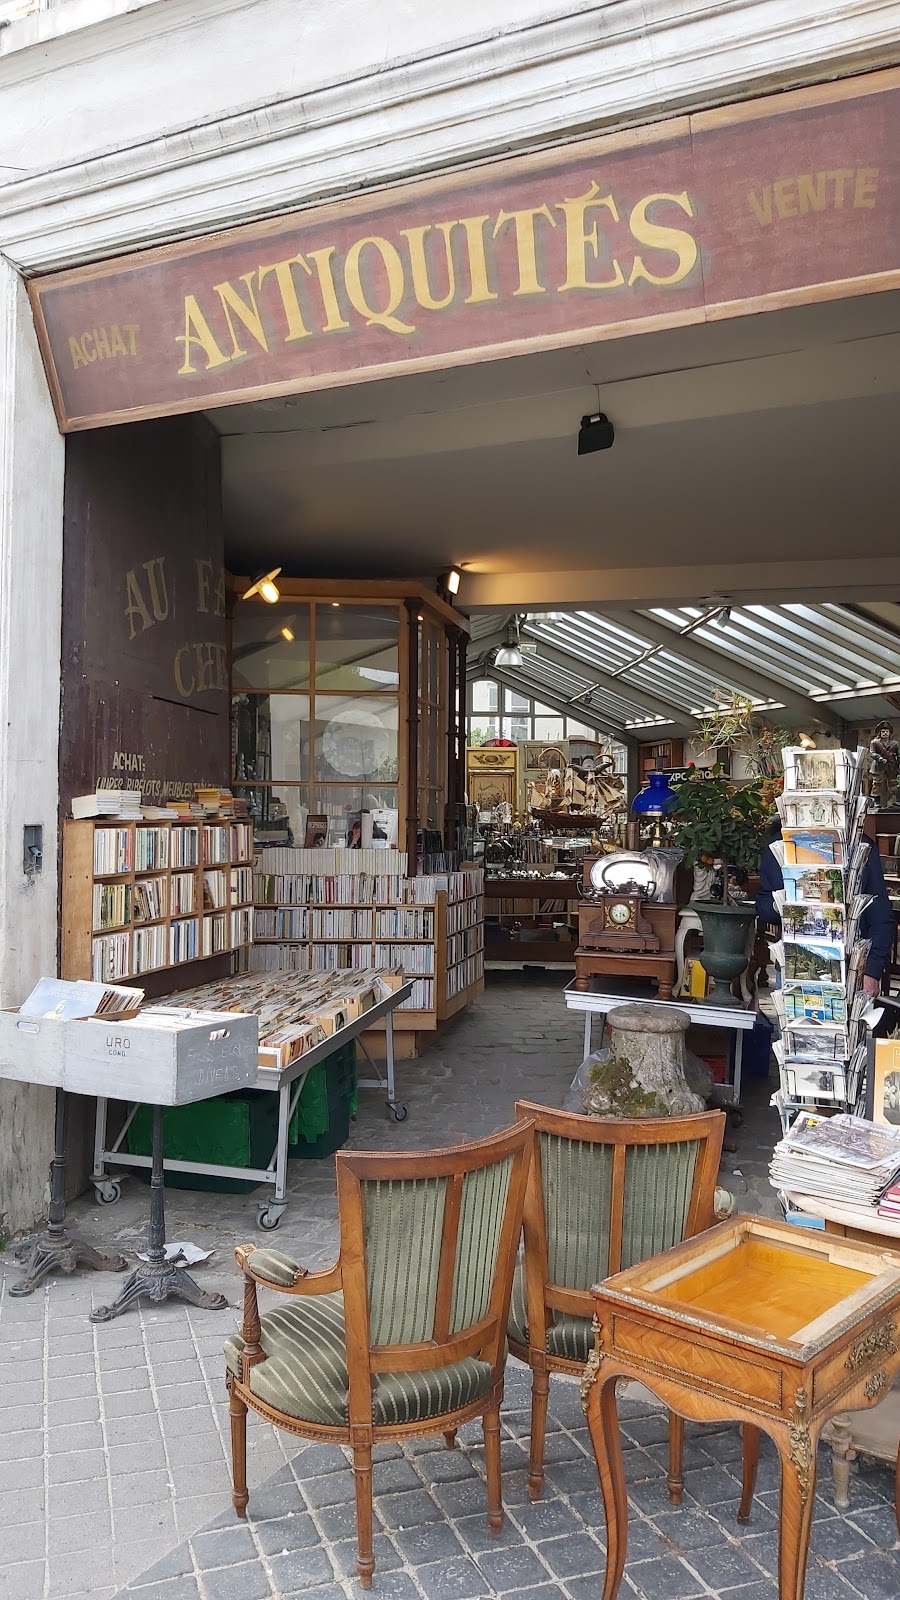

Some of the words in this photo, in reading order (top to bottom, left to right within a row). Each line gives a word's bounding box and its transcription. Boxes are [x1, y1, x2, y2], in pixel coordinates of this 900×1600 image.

[68, 324, 141, 370] ACHAT
[175, 180, 698, 376] ANTIQUITÉS
[748, 167, 880, 227] VENTE
[124, 556, 170, 641] AU
[112, 751, 146, 772] ACHAT:
[106, 1036, 131, 1049] URO
